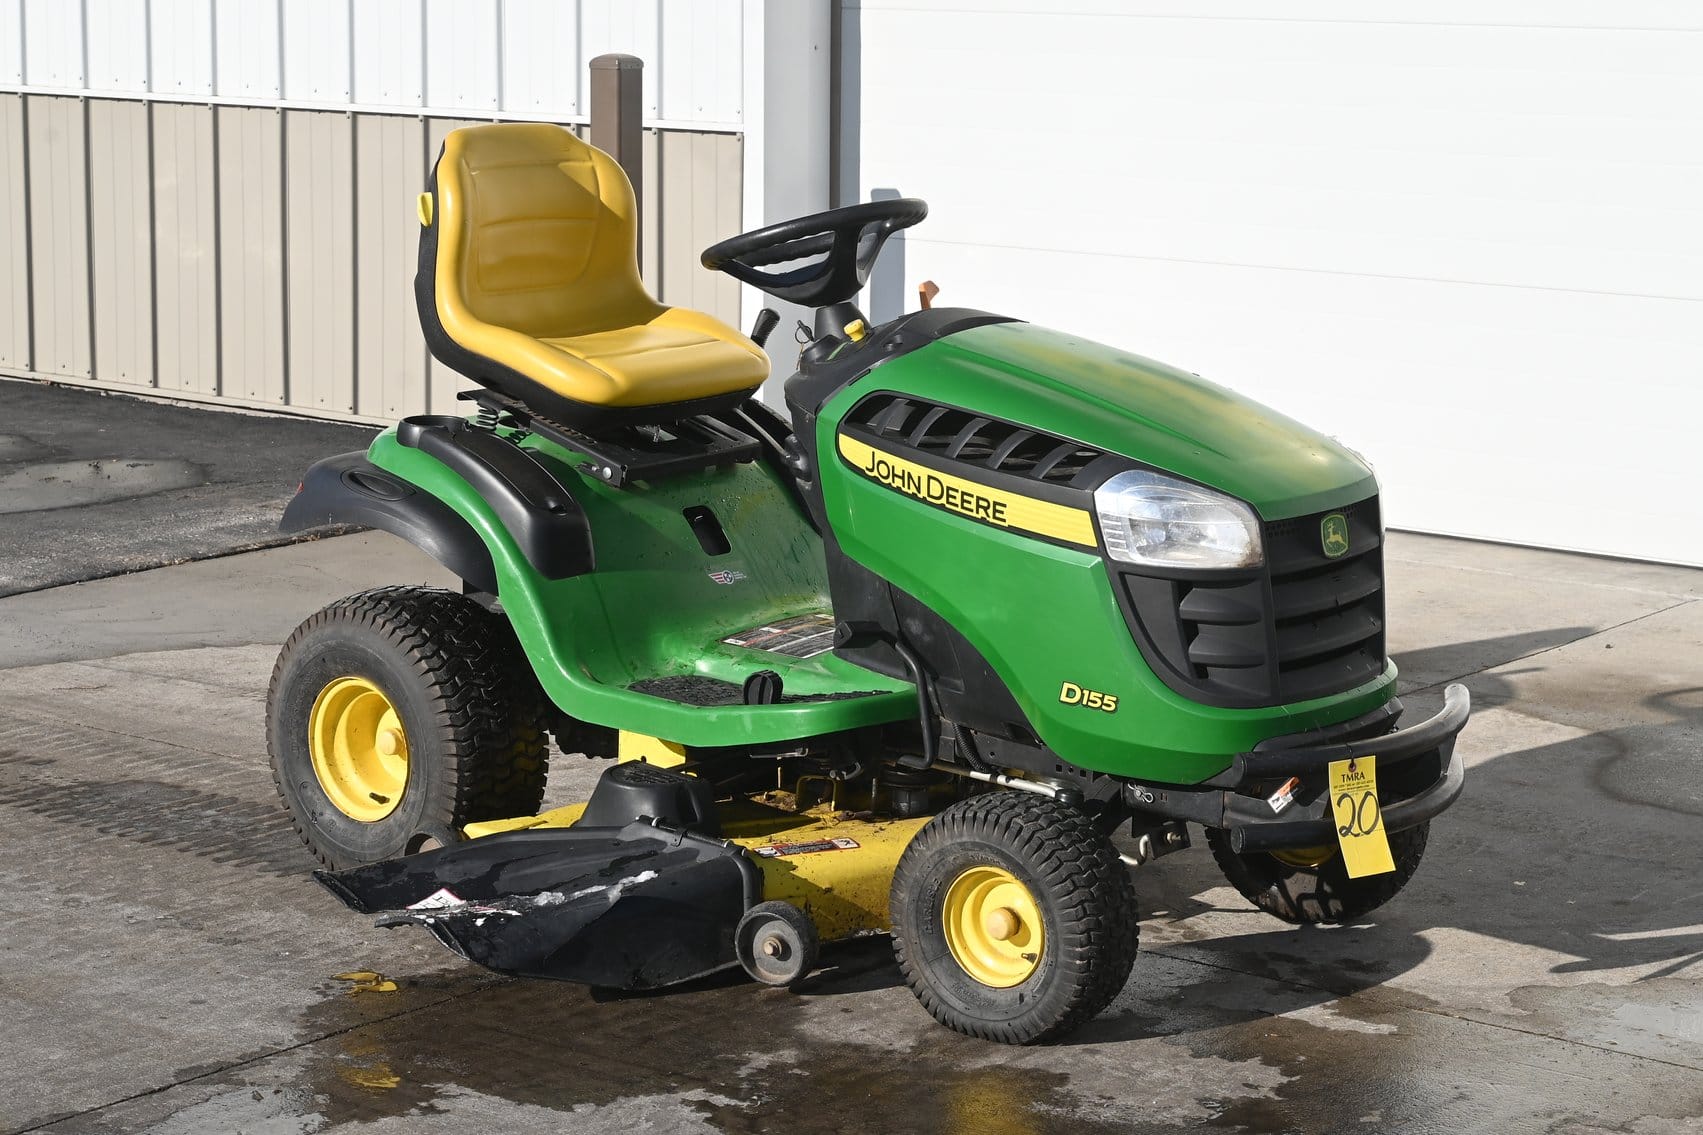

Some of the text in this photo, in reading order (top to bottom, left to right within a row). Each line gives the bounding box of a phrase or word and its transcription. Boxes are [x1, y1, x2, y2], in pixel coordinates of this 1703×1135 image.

[865, 451, 1008, 523] JOHN DEERE
[1059, 681, 1118, 713] D155
[1341, 771, 1366, 783] TMRA
[1336, 790, 1380, 838] 20
